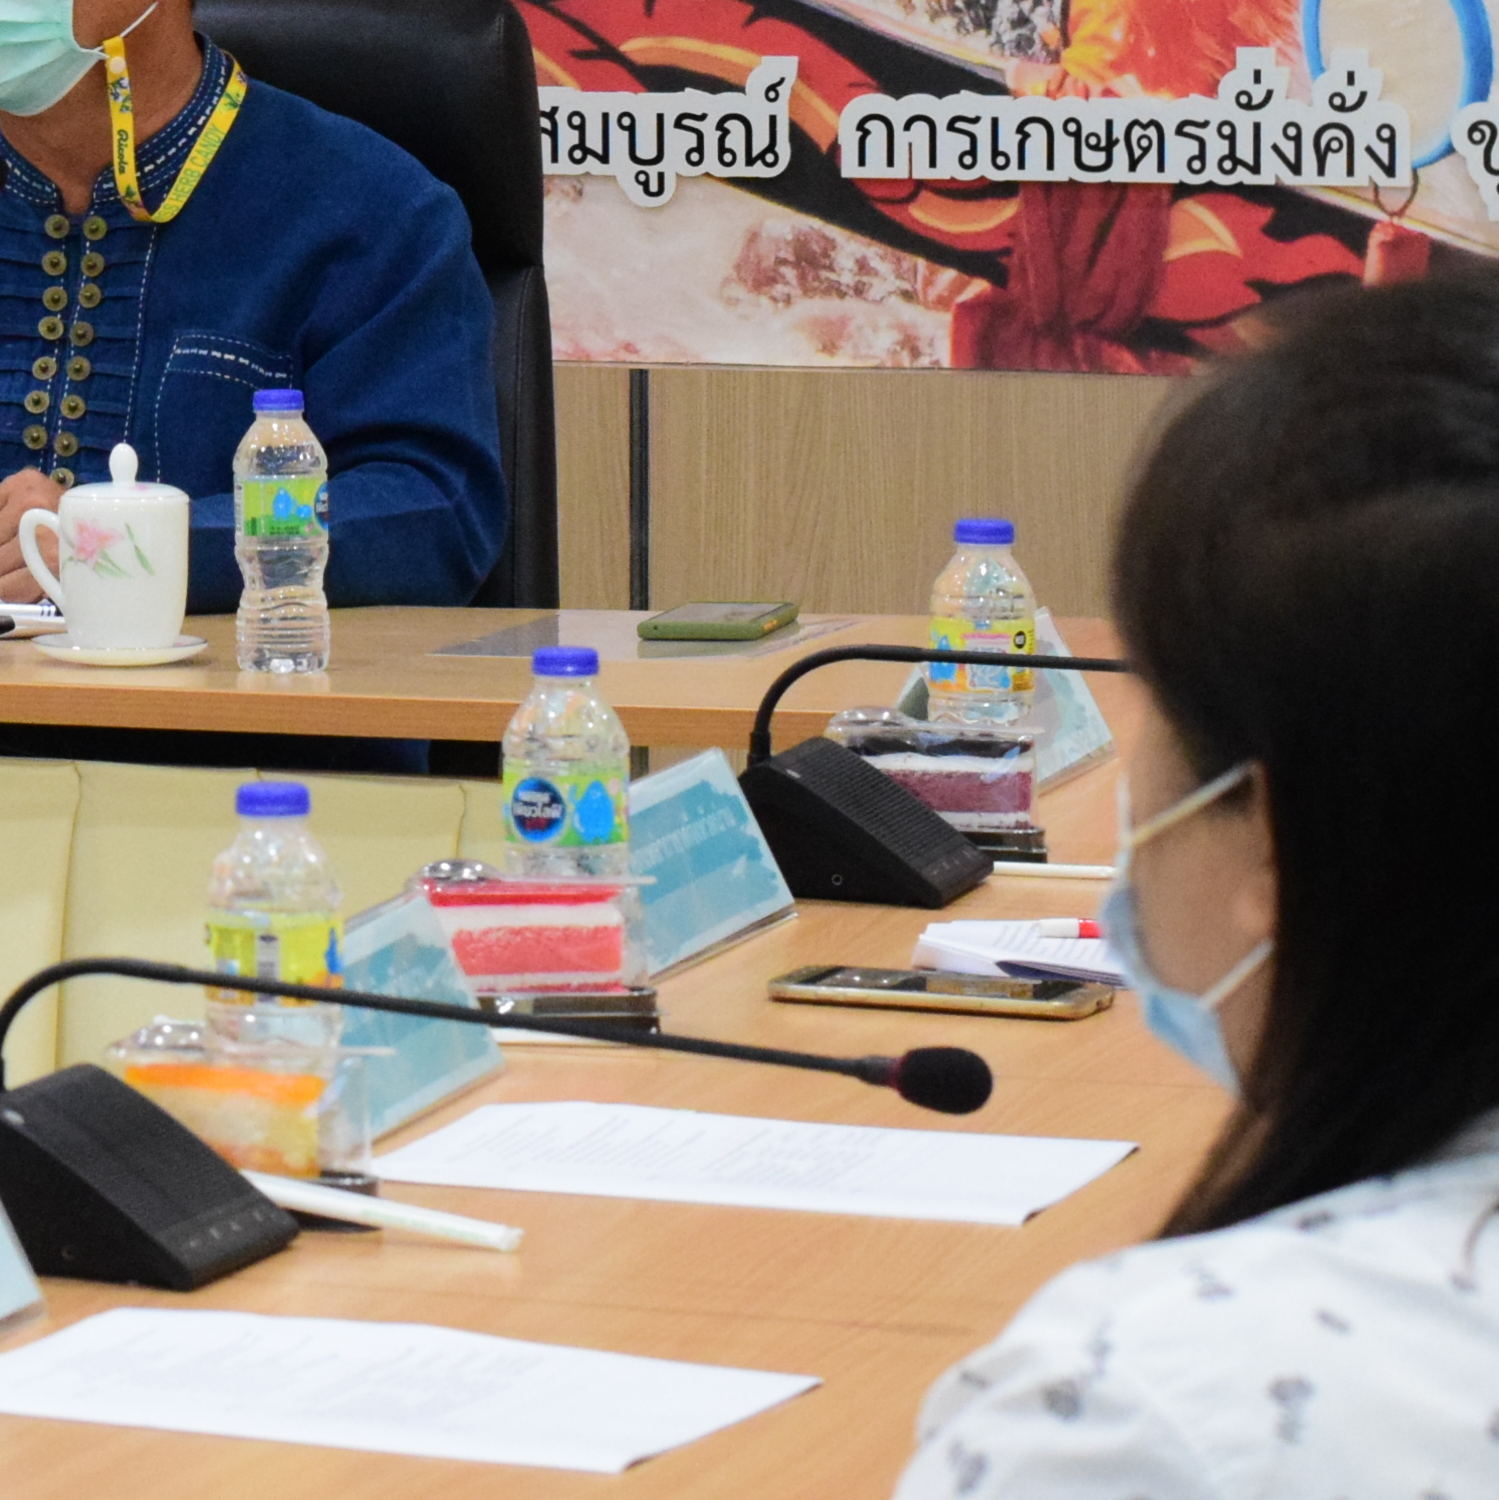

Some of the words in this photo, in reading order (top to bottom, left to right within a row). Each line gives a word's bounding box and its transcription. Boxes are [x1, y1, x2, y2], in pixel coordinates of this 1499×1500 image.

[116, 128, 129, 175] Ricola
[174, 167, 202, 203] HERB
[191, 123, 226, 168] CANDY
[855, 69, 1397, 179] การเกษตรมั่งคั่ง
